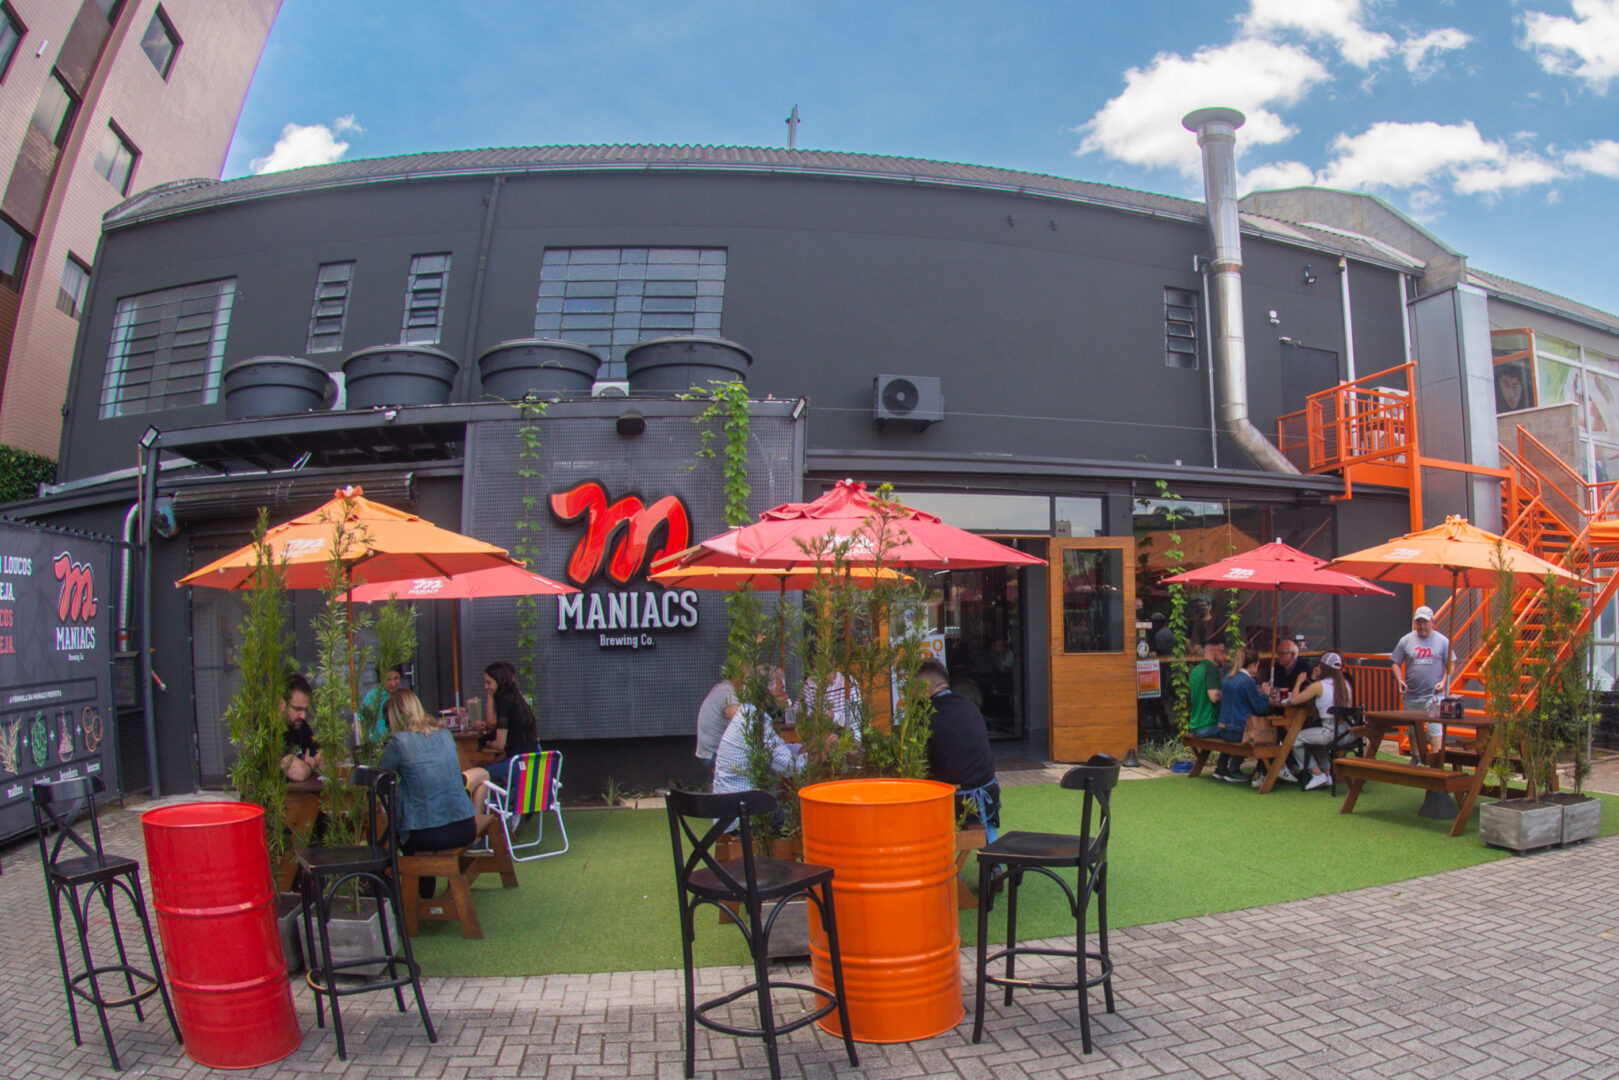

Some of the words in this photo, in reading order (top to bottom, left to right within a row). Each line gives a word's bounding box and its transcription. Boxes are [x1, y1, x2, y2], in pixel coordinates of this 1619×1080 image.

[4, 555, 32, 576] LOUCOS
[557, 590, 698, 631] MANIACS
[55, 626, 96, 651] MANIACS
[600, 634, 638, 649] Brewing
[641, 633, 655, 646] Co.
